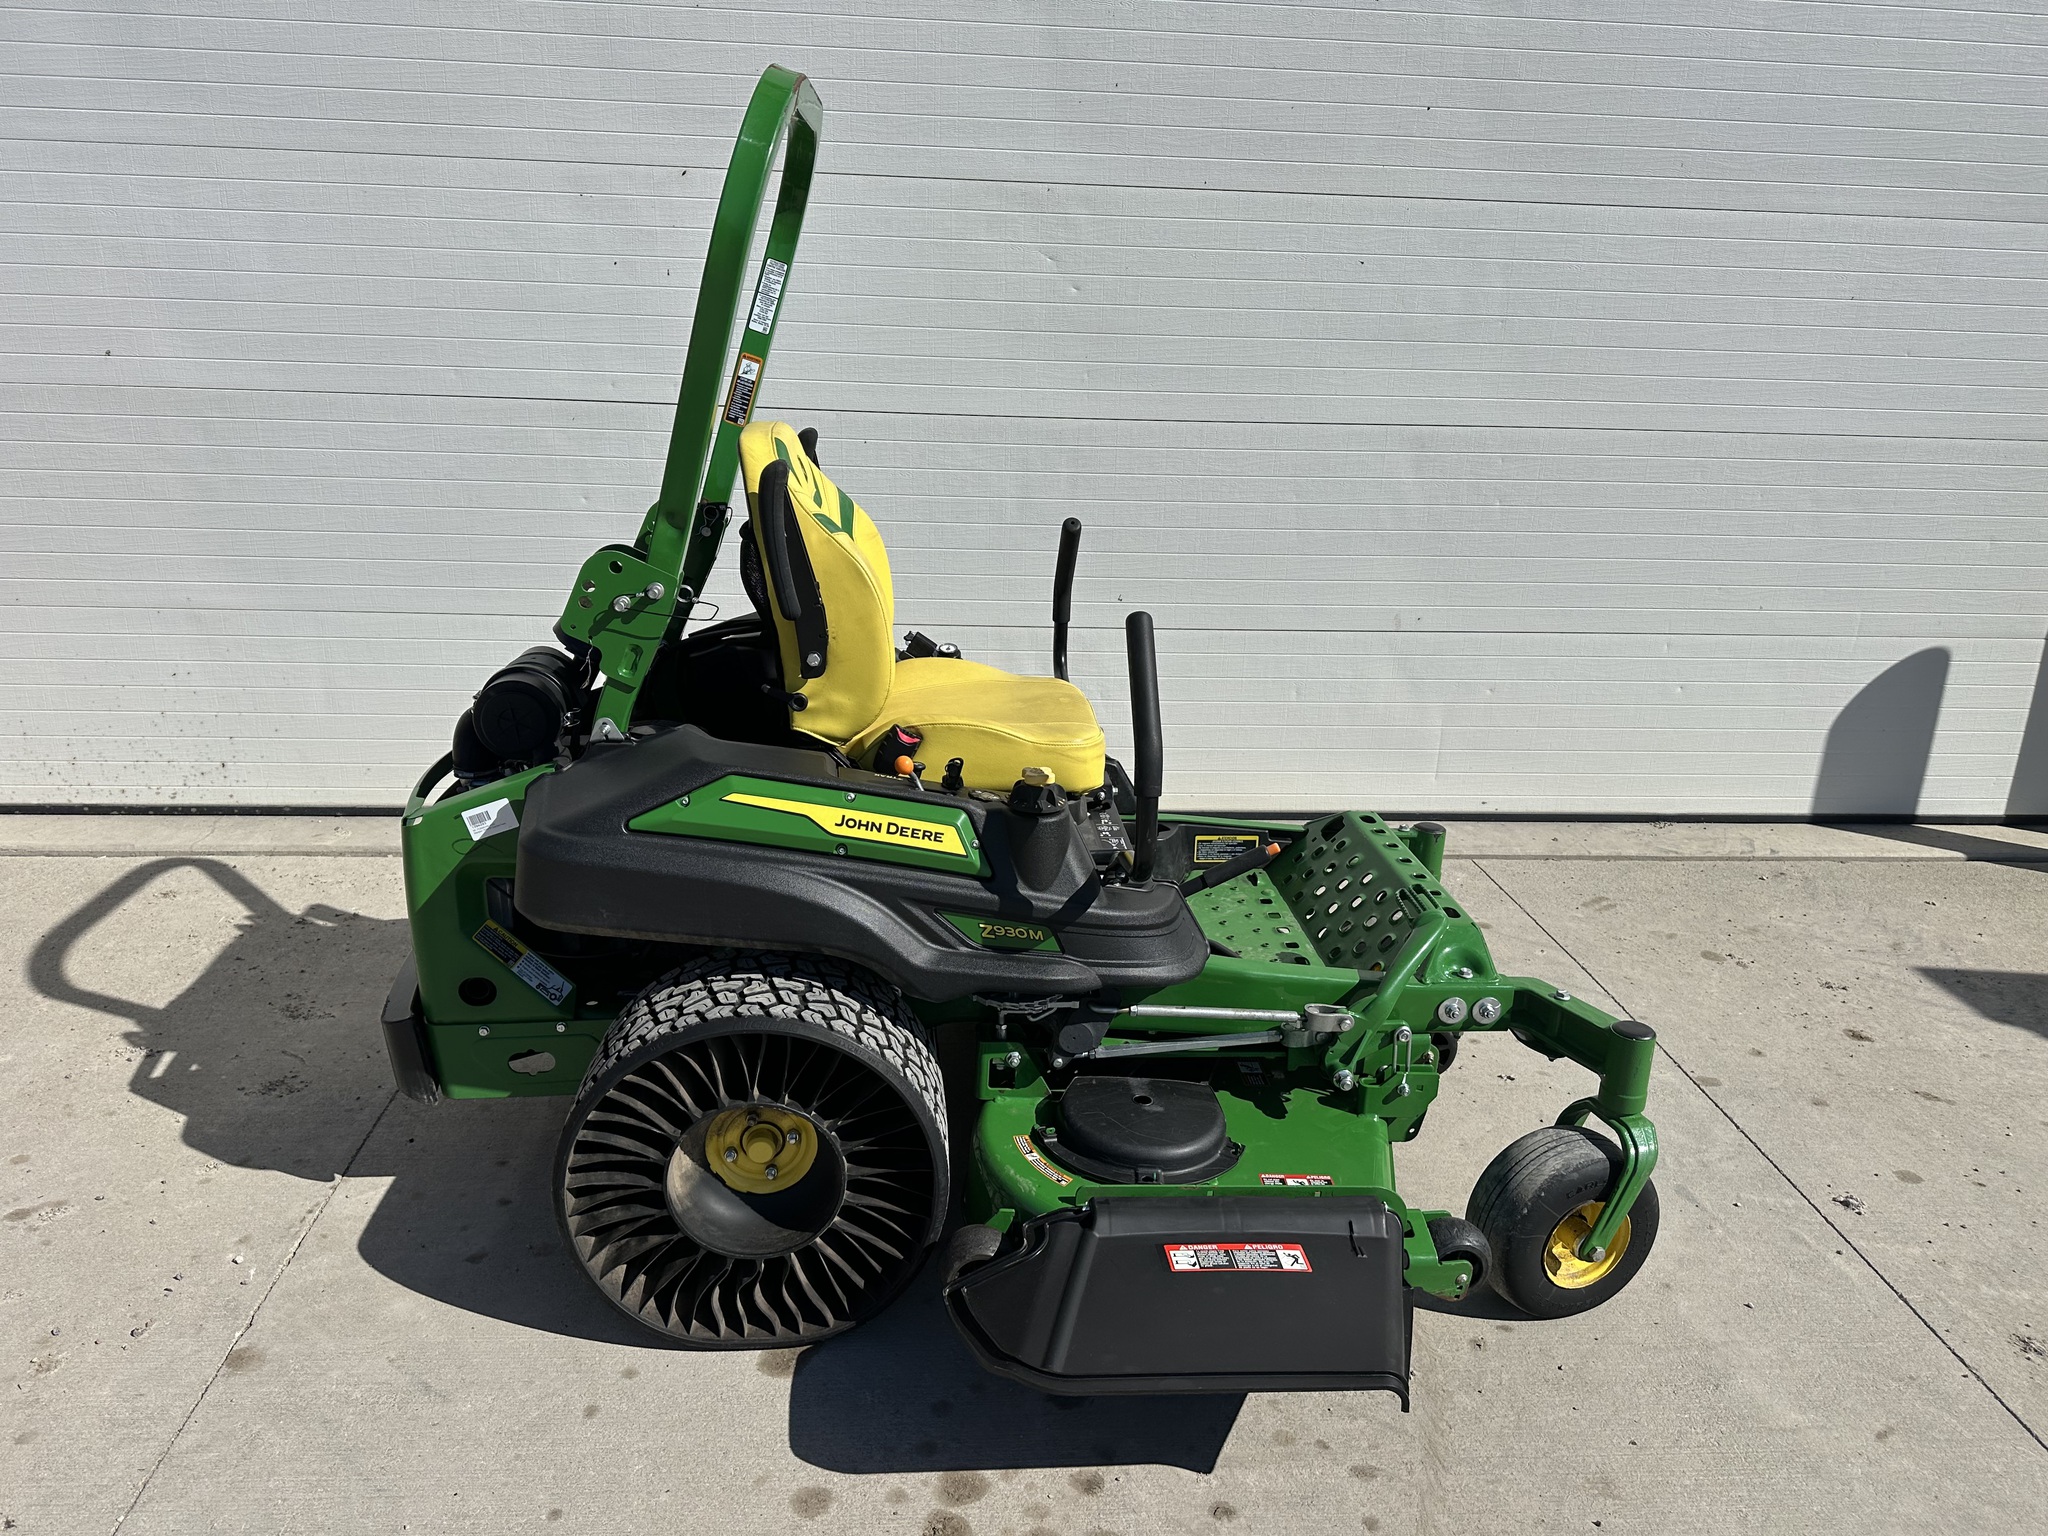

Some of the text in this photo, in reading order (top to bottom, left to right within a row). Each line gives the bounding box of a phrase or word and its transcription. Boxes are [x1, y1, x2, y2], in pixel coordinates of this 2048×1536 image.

[835, 814, 944, 843] JOHN DEERE
[497, 929, 519, 947] CAUTION
